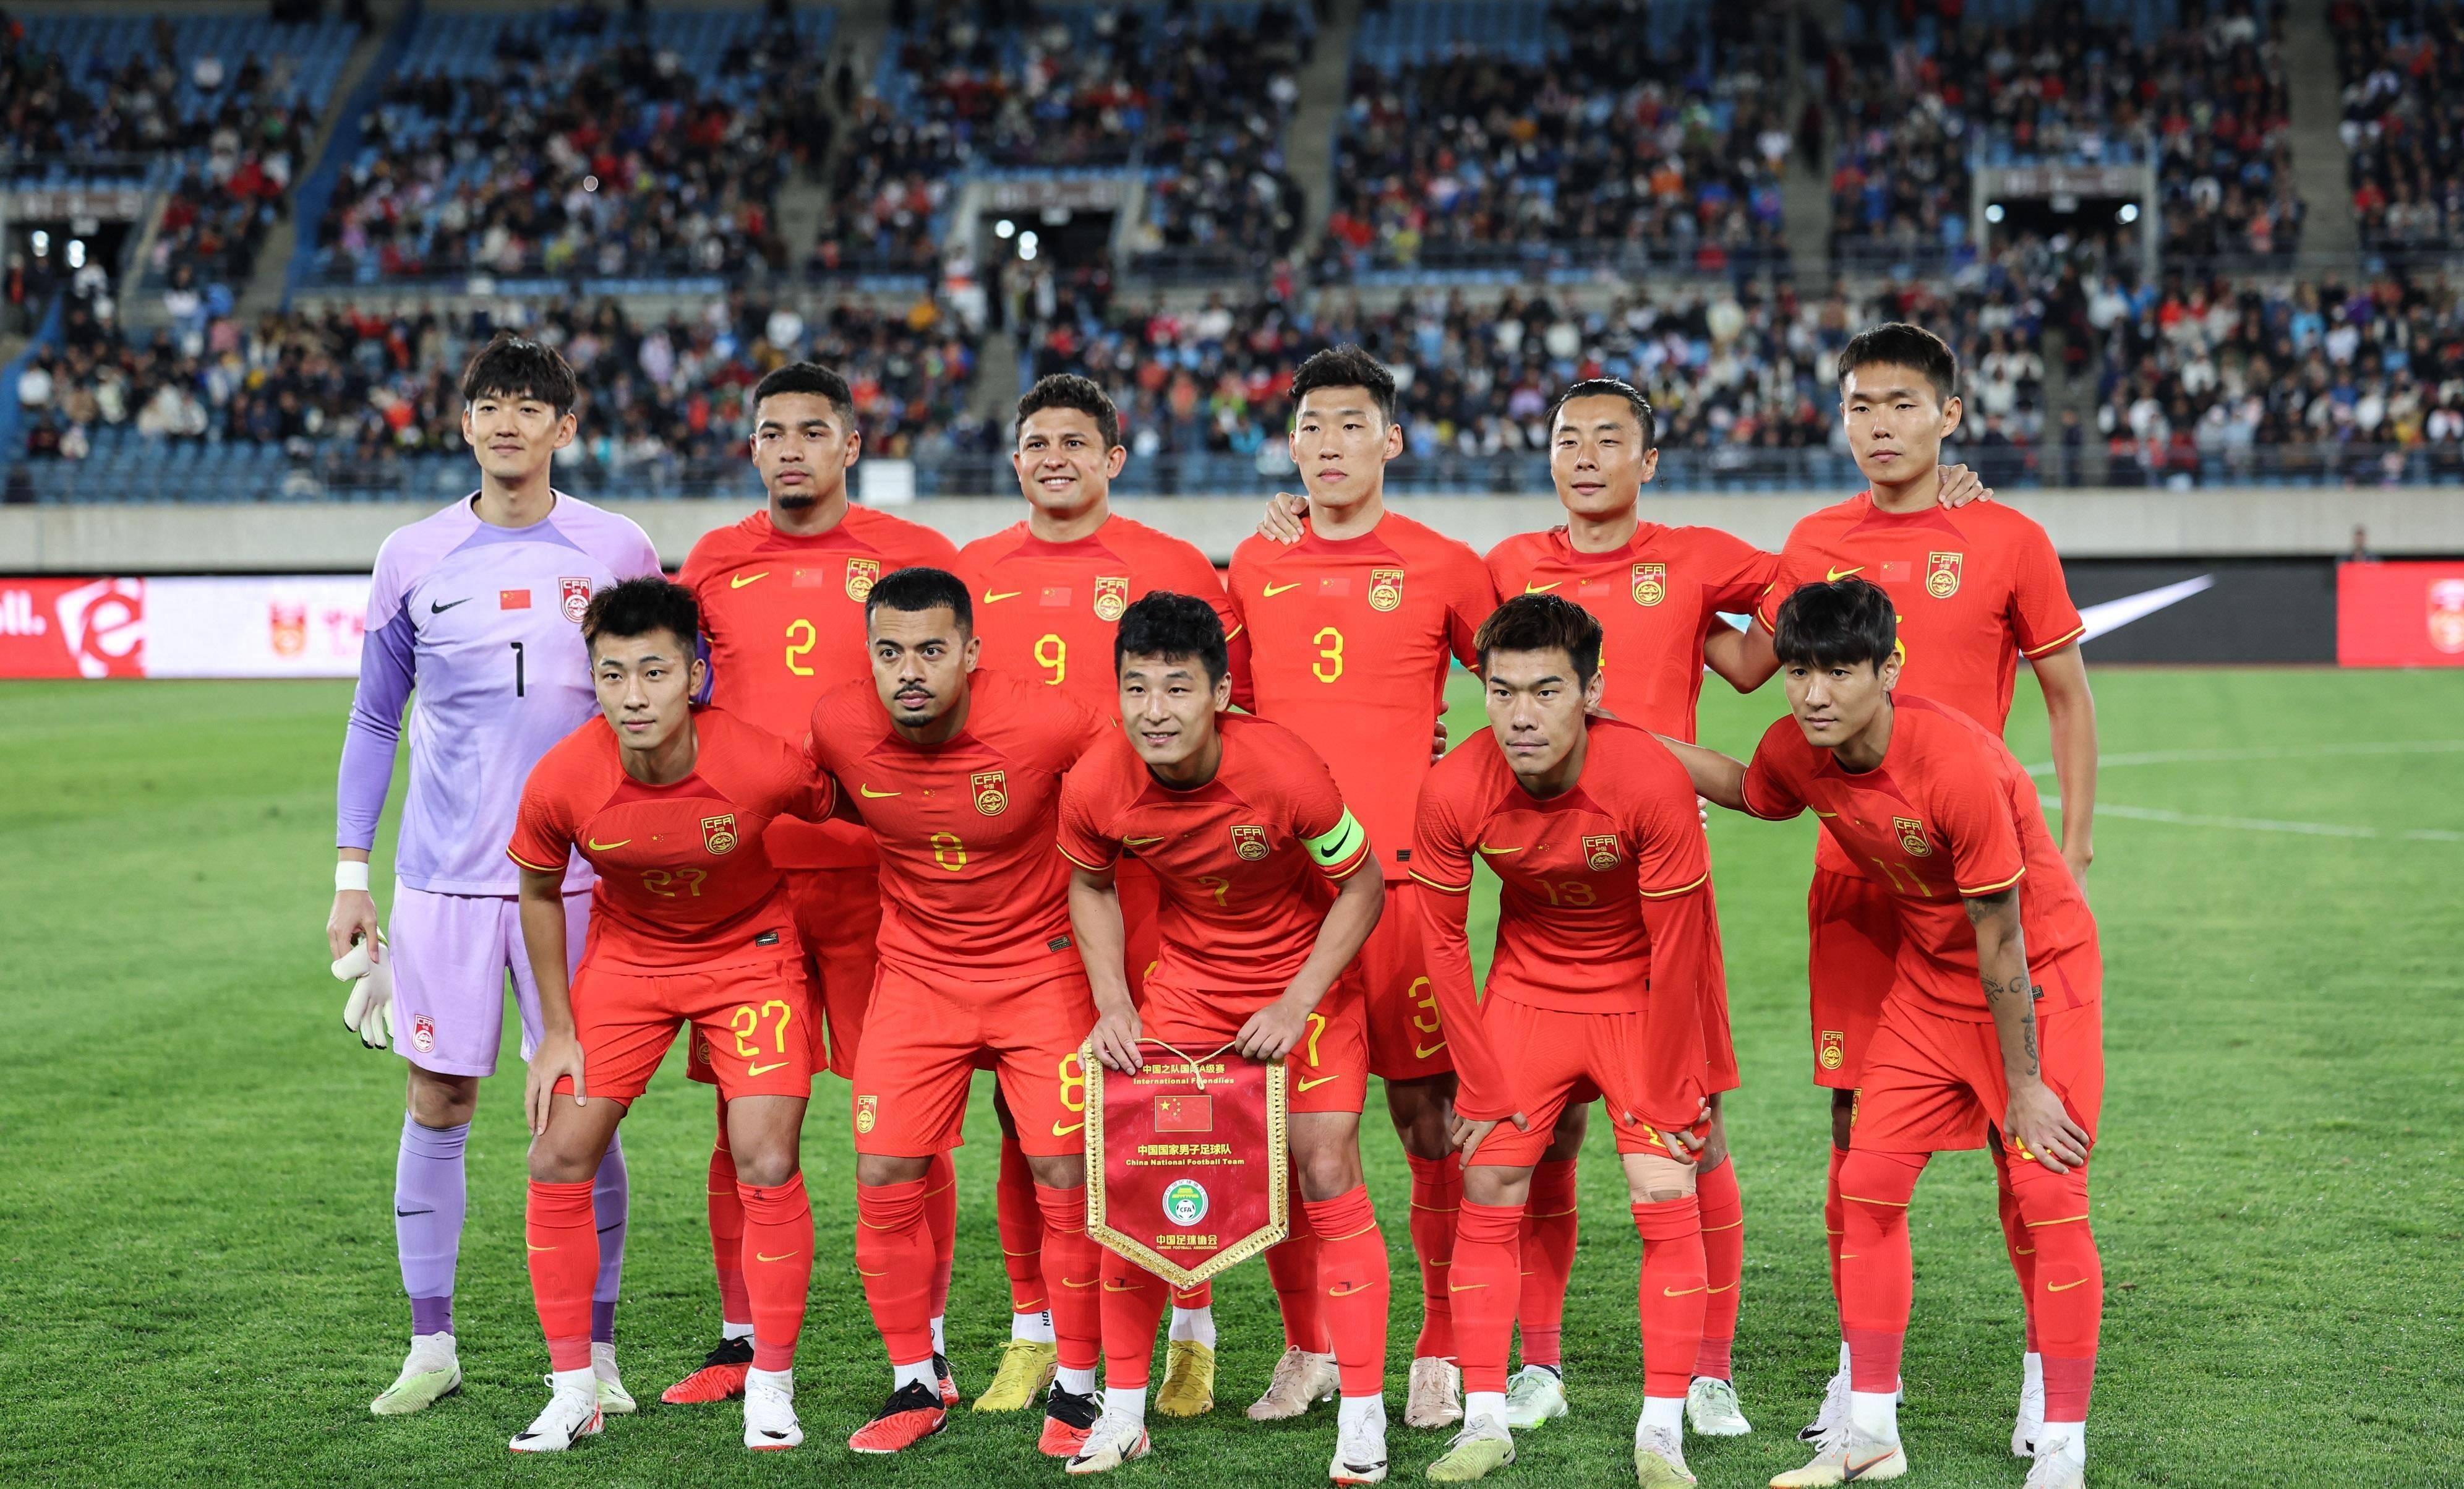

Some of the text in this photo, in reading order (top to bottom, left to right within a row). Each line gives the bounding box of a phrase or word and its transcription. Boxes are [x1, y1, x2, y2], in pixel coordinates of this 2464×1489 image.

[851, 561, 876, 572] CFA
[1932, 555, 1959, 564] CFA
[1374, 572, 1401, 580] CFA
[1636, 566, 1662, 574] CFA
[563, 581, 588, 589] CFA
[1099, 580, 1125, 589] CFA
[785, 619, 816, 676] 2
[1312, 627, 1344, 684] 3
[1034, 633, 1066, 685] 9
[510, 642, 524, 697] 1
[974, 774, 1001, 785] CFA
[705, 817, 732, 829] CFA
[1896, 820, 1920, 831] CFA
[1586, 838, 1614, 847] CFA
[930, 831, 967, 871] 8
[641, 868, 707, 896] 27
[1871, 857, 1932, 896] 11
[1198, 876, 1230, 906] 7
[1534, 879, 1597, 906] 13
[1408, 976, 1442, 1032] 3
[417, 1018, 433, 1028] CFA
[730, 1000, 791, 1057] 27
[1306, 1013, 1325, 1066] 7
[1058, 1053, 1085, 1112] 8
[1138, 1144, 1231, 1156] 中国国家男子足球队
[1157, 1235, 1217, 1245] 中国足球协会
[1042, 1310, 1050, 1326] GN
